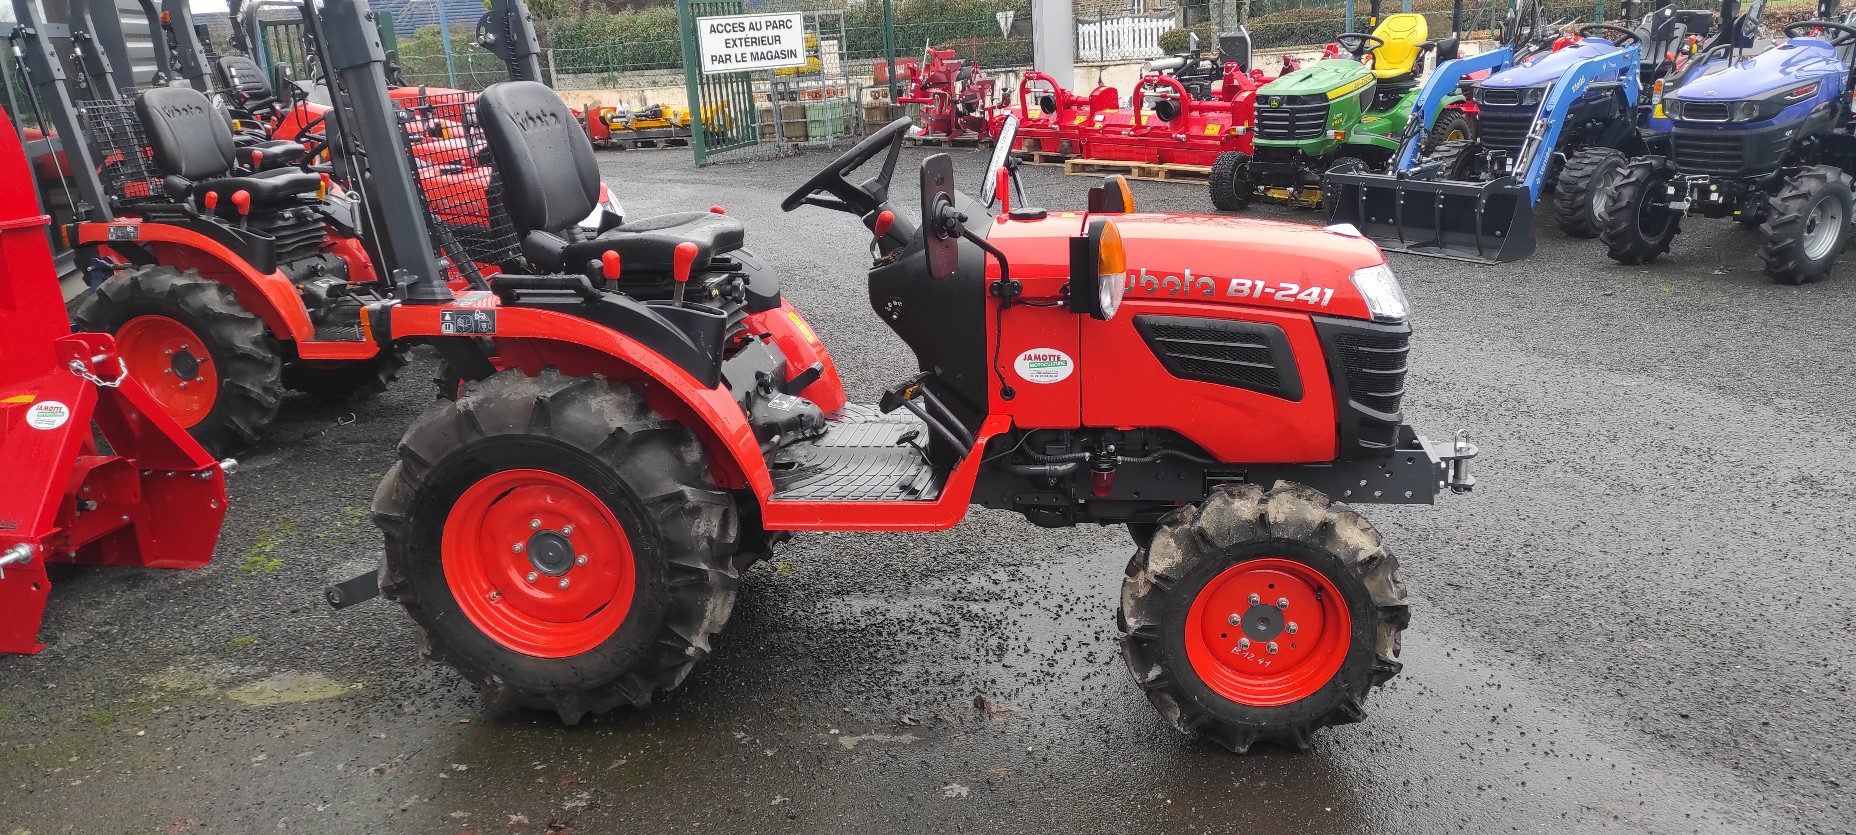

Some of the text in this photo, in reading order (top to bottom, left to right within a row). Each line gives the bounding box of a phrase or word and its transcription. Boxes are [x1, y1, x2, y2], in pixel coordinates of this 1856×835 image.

[709, 19, 793, 35] ACCES AU PARC
[724, 34, 782, 49] EXTÉRIEUR
[710, 48, 798, 65] PAR LE MAGASIN
[1124, 267, 1335, 307] ubota B1-241
[1023, 353, 1062, 362] JAMOTTE
[36, 404, 63, 413] JAMOTTE
